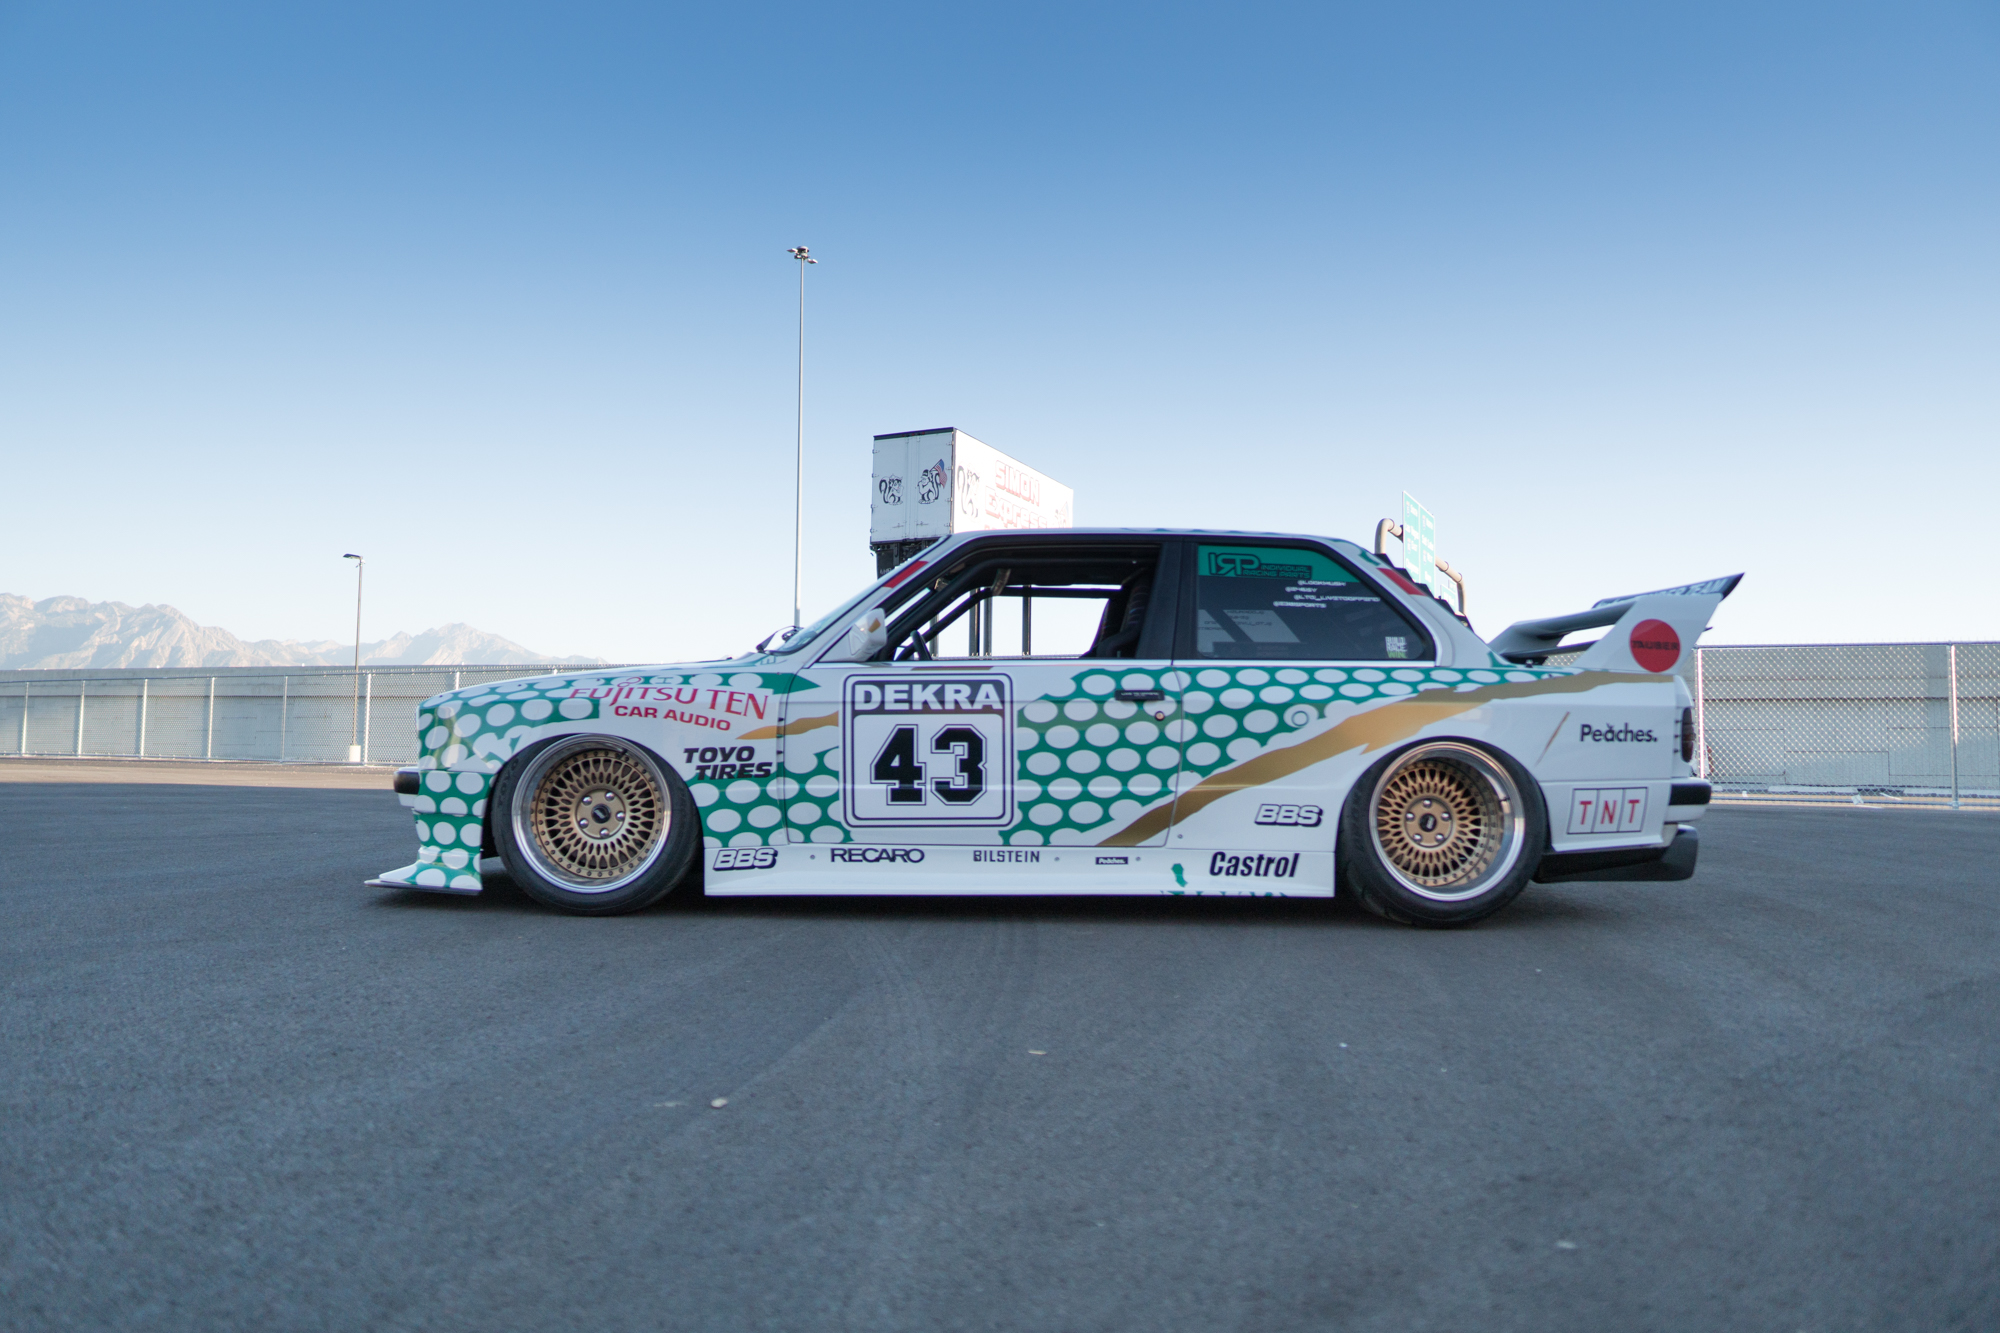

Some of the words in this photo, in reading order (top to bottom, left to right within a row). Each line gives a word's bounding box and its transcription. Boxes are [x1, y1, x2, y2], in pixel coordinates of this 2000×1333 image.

[995, 460, 1040, 507] SIMON
[985, 485, 1048, 529] Express
[1243, 570, 1277, 578] RACING
[1279, 571, 1311, 579] PARTS
[1261, 564, 1311, 573] INDIVIDUAL
[569, 677, 699, 707] FUJITSU
[706, 688, 769, 720] TEN
[854, 683, 1004, 711] DEKRA
[614, 705, 658, 719] CAR
[663, 708, 731, 732] AUDIO
[683, 745, 755, 763] TOYO
[870, 724, 988, 806] 43
[695, 762, 773, 780] TIRES
[1254, 804, 1324, 827] BBS
[713, 847, 778, 871] BBS
[830, 848, 925, 863] RECARO
[973, 850, 1040, 863] BILSTEIN
[1209, 851, 1301, 877] Castrol
